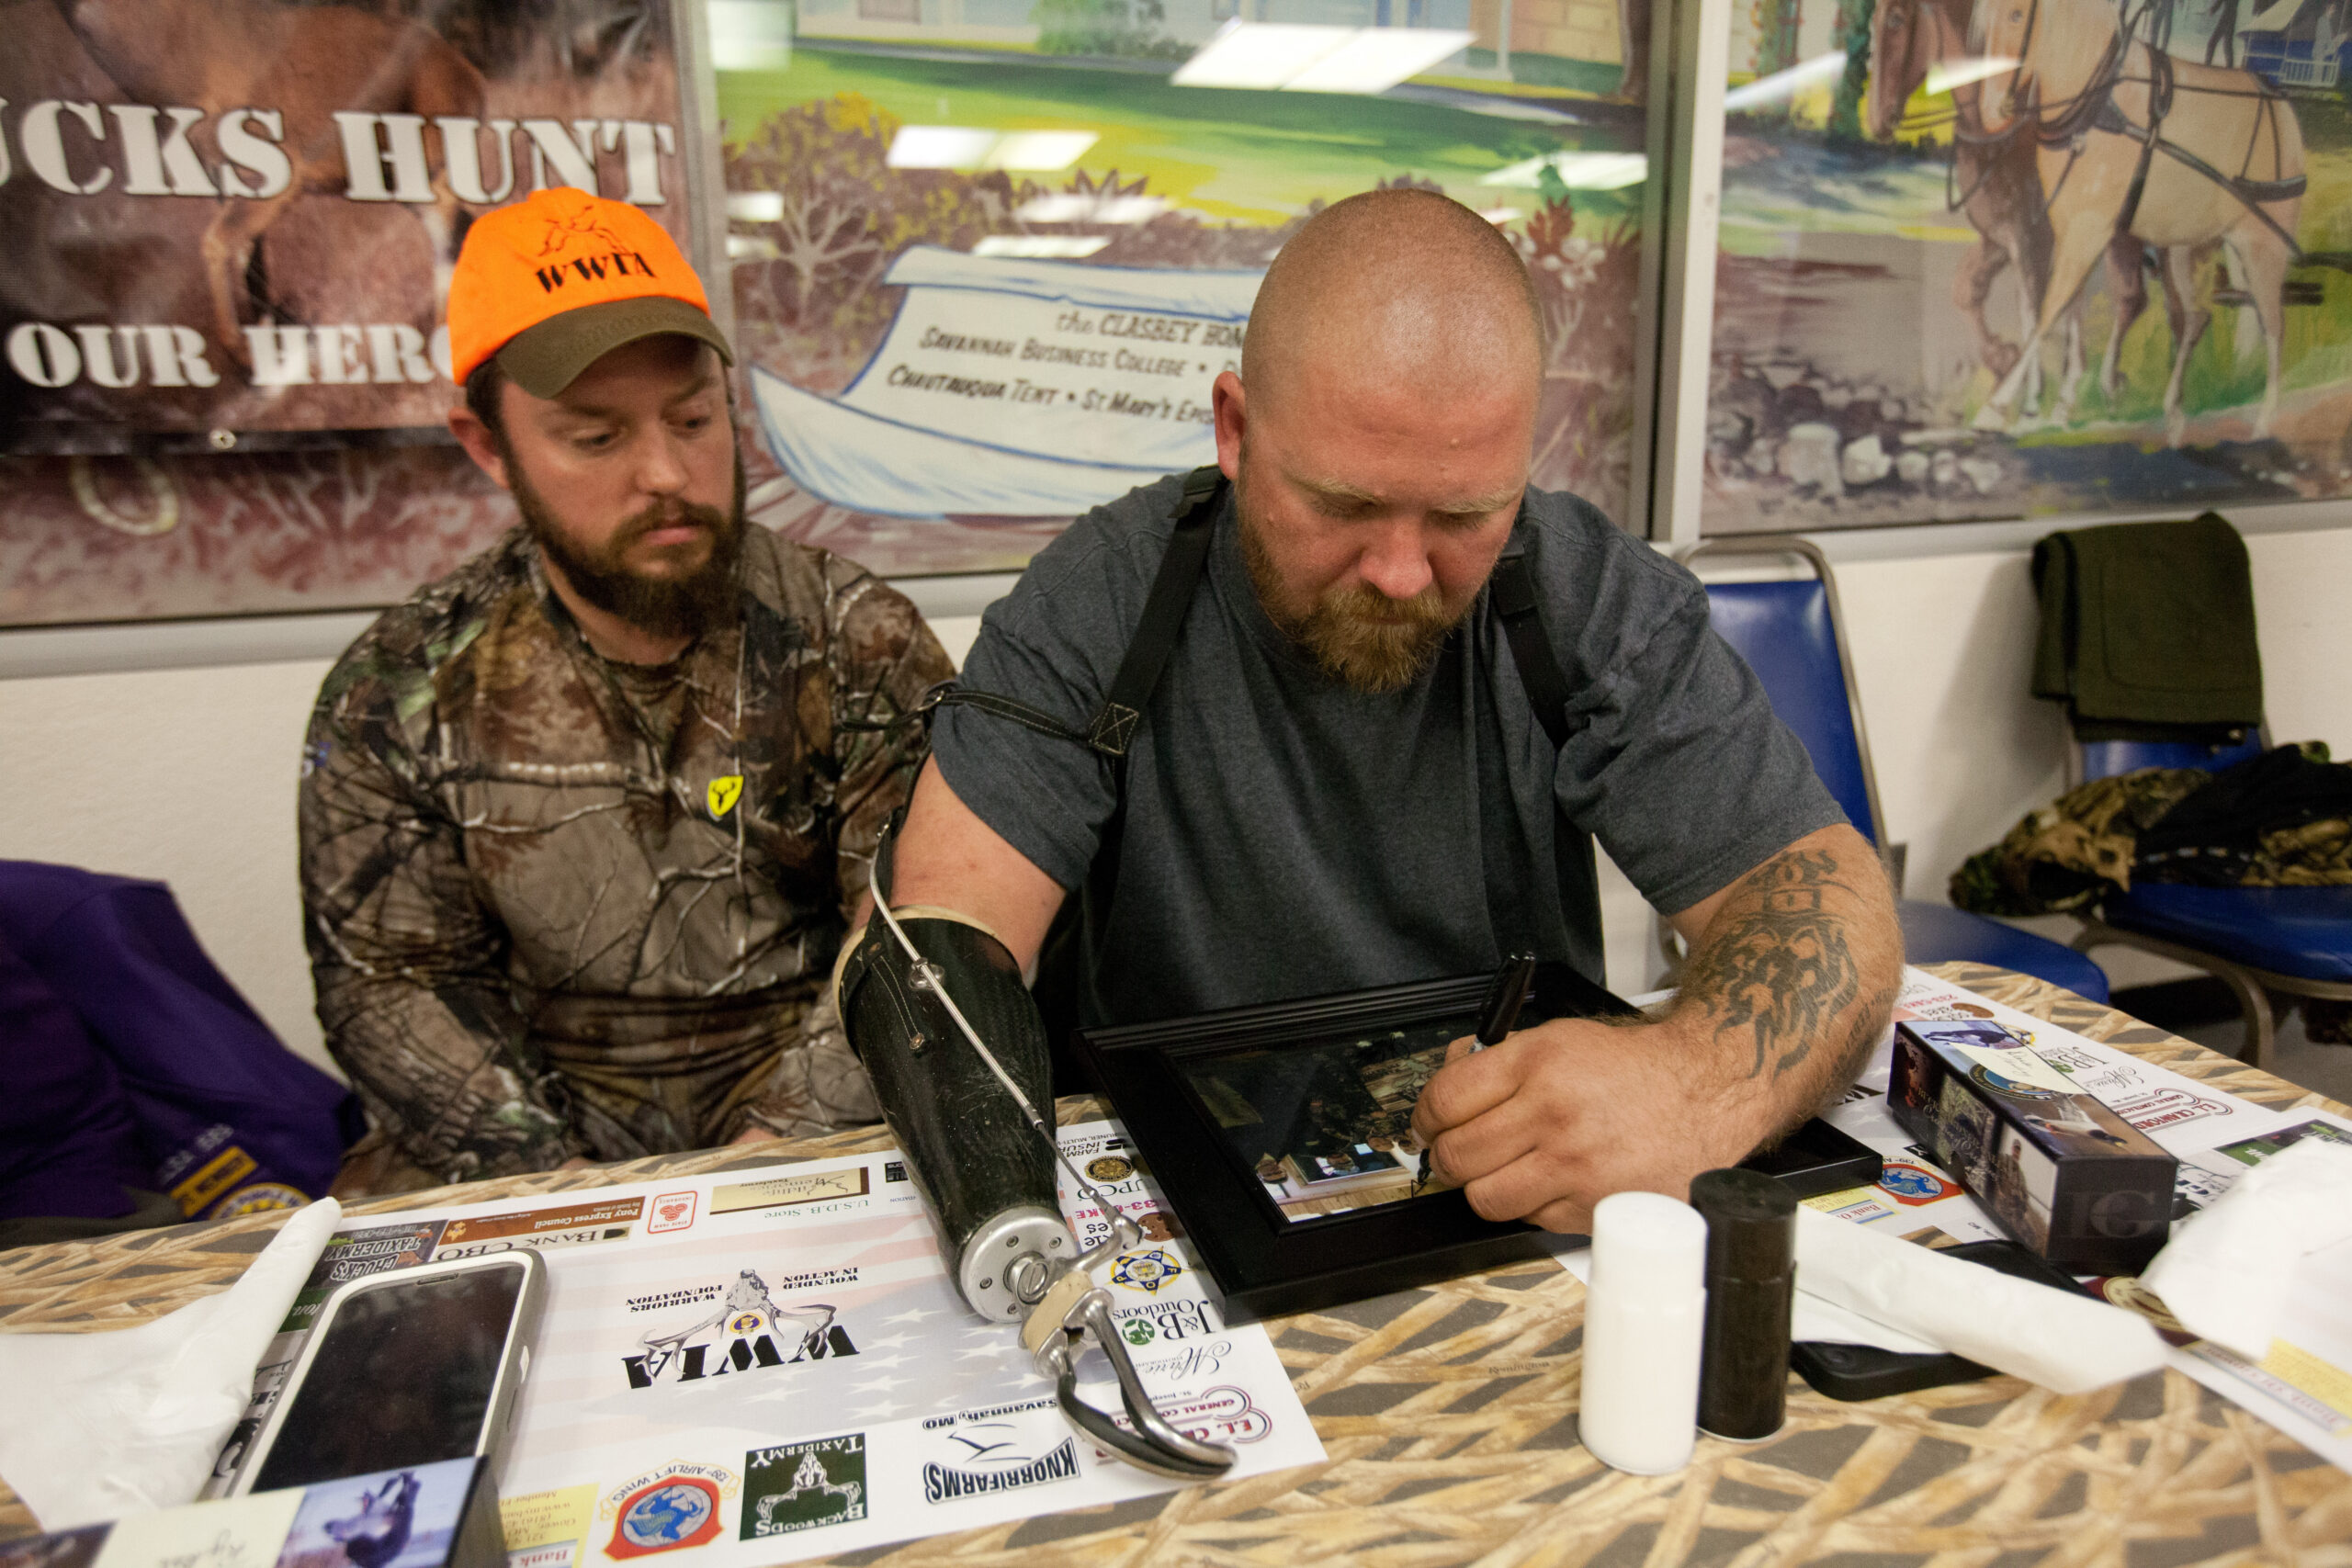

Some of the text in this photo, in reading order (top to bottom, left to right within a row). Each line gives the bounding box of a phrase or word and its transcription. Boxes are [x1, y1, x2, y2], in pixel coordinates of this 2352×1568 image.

[0, 96, 674, 205] CKS HUNT
[7, 321, 220, 388] OUR
[574, 1209, 612, 1224] Express
[615, 1207, 639, 1222] Pony
[1849, 1204, 1881, 1217] Bank
[535, 1217, 572, 1229] Council
[324, 1237, 422, 1262] TAXIDERMY
[526, 1231, 597, 1248] BANK
[782, 1274, 859, 1290] WOUNDED
[783, 1268, 859, 1283] IN ACTION
[626, 1284, 723, 1306] FOUNDATION
[630, 1292, 716, 1314] WARRIORS
[1113, 1298, 1195, 1321] Outdoors
[621, 1325, 861, 1390] WWIA
[1183, 1399, 1236, 1415] GENERAL
[922, 1415, 957, 1430] MO
[751, 1436, 864, 1468] TAXIDERMY
[613, 1474, 651, 1503] WING
[755, 1502, 865, 1537] BACKWOODS
